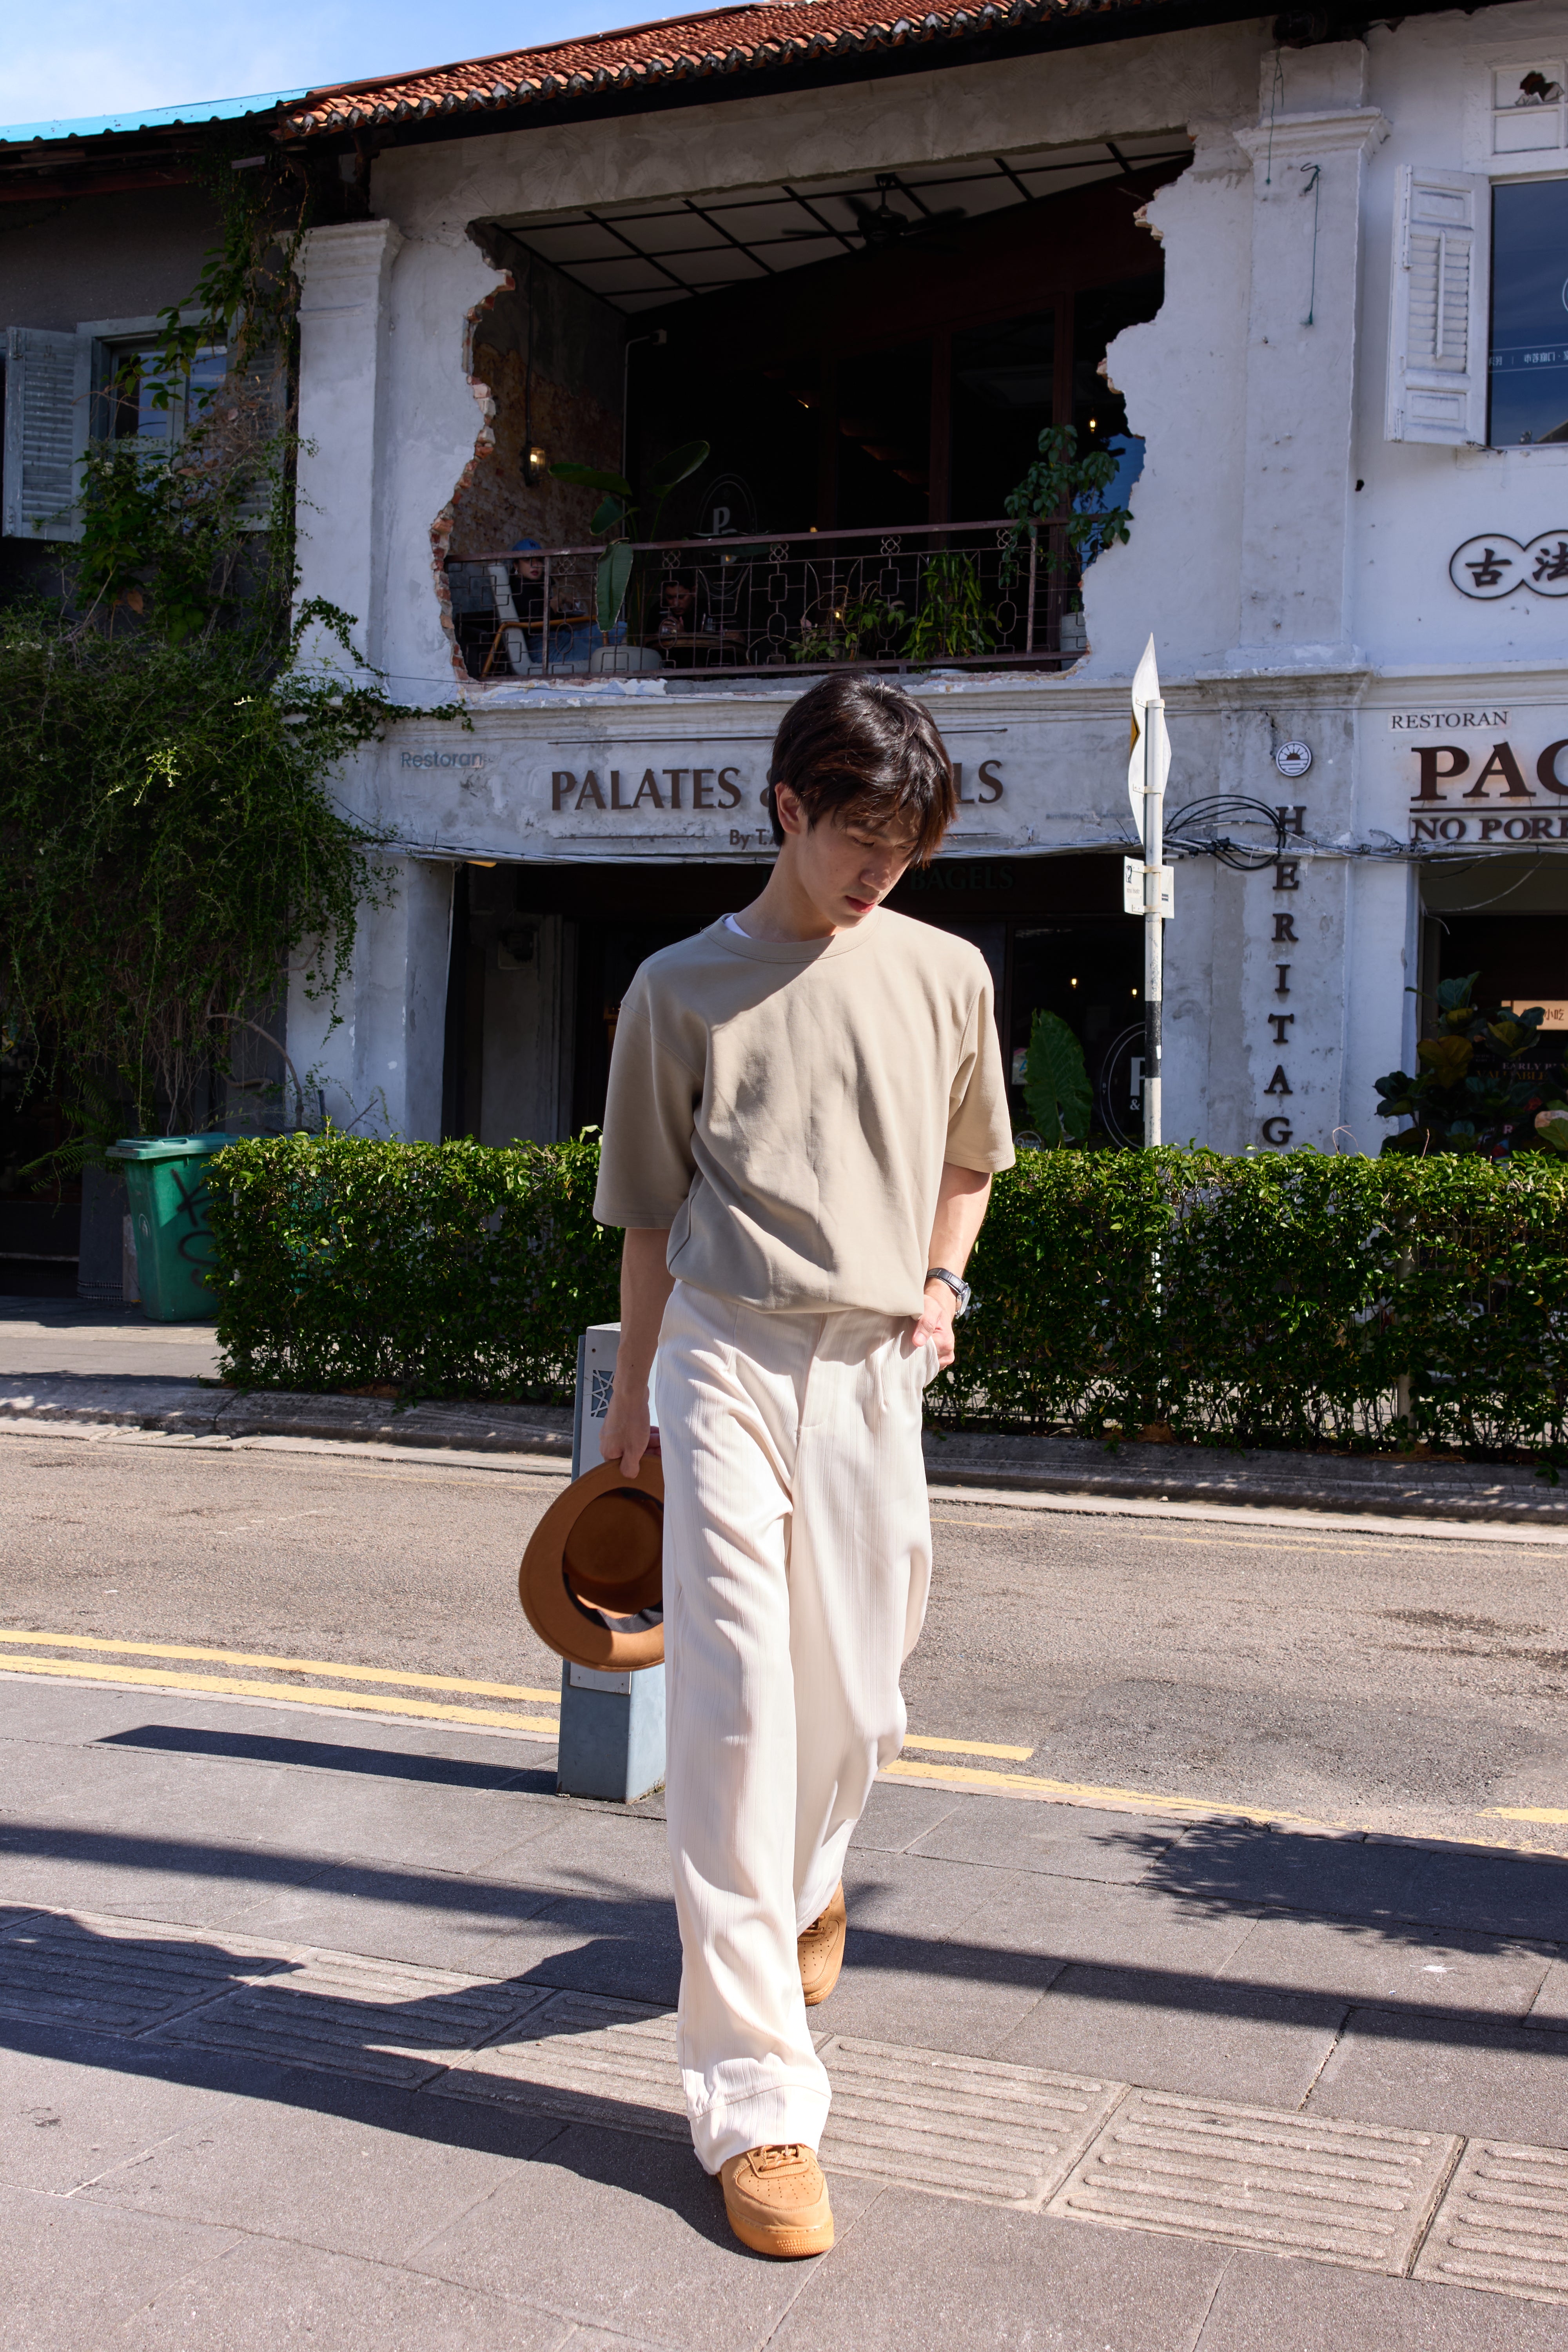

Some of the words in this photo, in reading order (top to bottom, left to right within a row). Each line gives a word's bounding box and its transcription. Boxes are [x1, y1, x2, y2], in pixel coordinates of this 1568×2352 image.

[1392, 711, 1509, 729] RESTORAN
[401, 751, 483, 768] Restoran
[552, 767, 742, 811] PALATES
[730, 829, 751, 850] By
[756, 829, 777, 845] T.
[1412, 818, 1466, 840] NO
[909, 865, 1015, 891] BAGELS
[1262, 806, 1307, 1145] HERITAG
